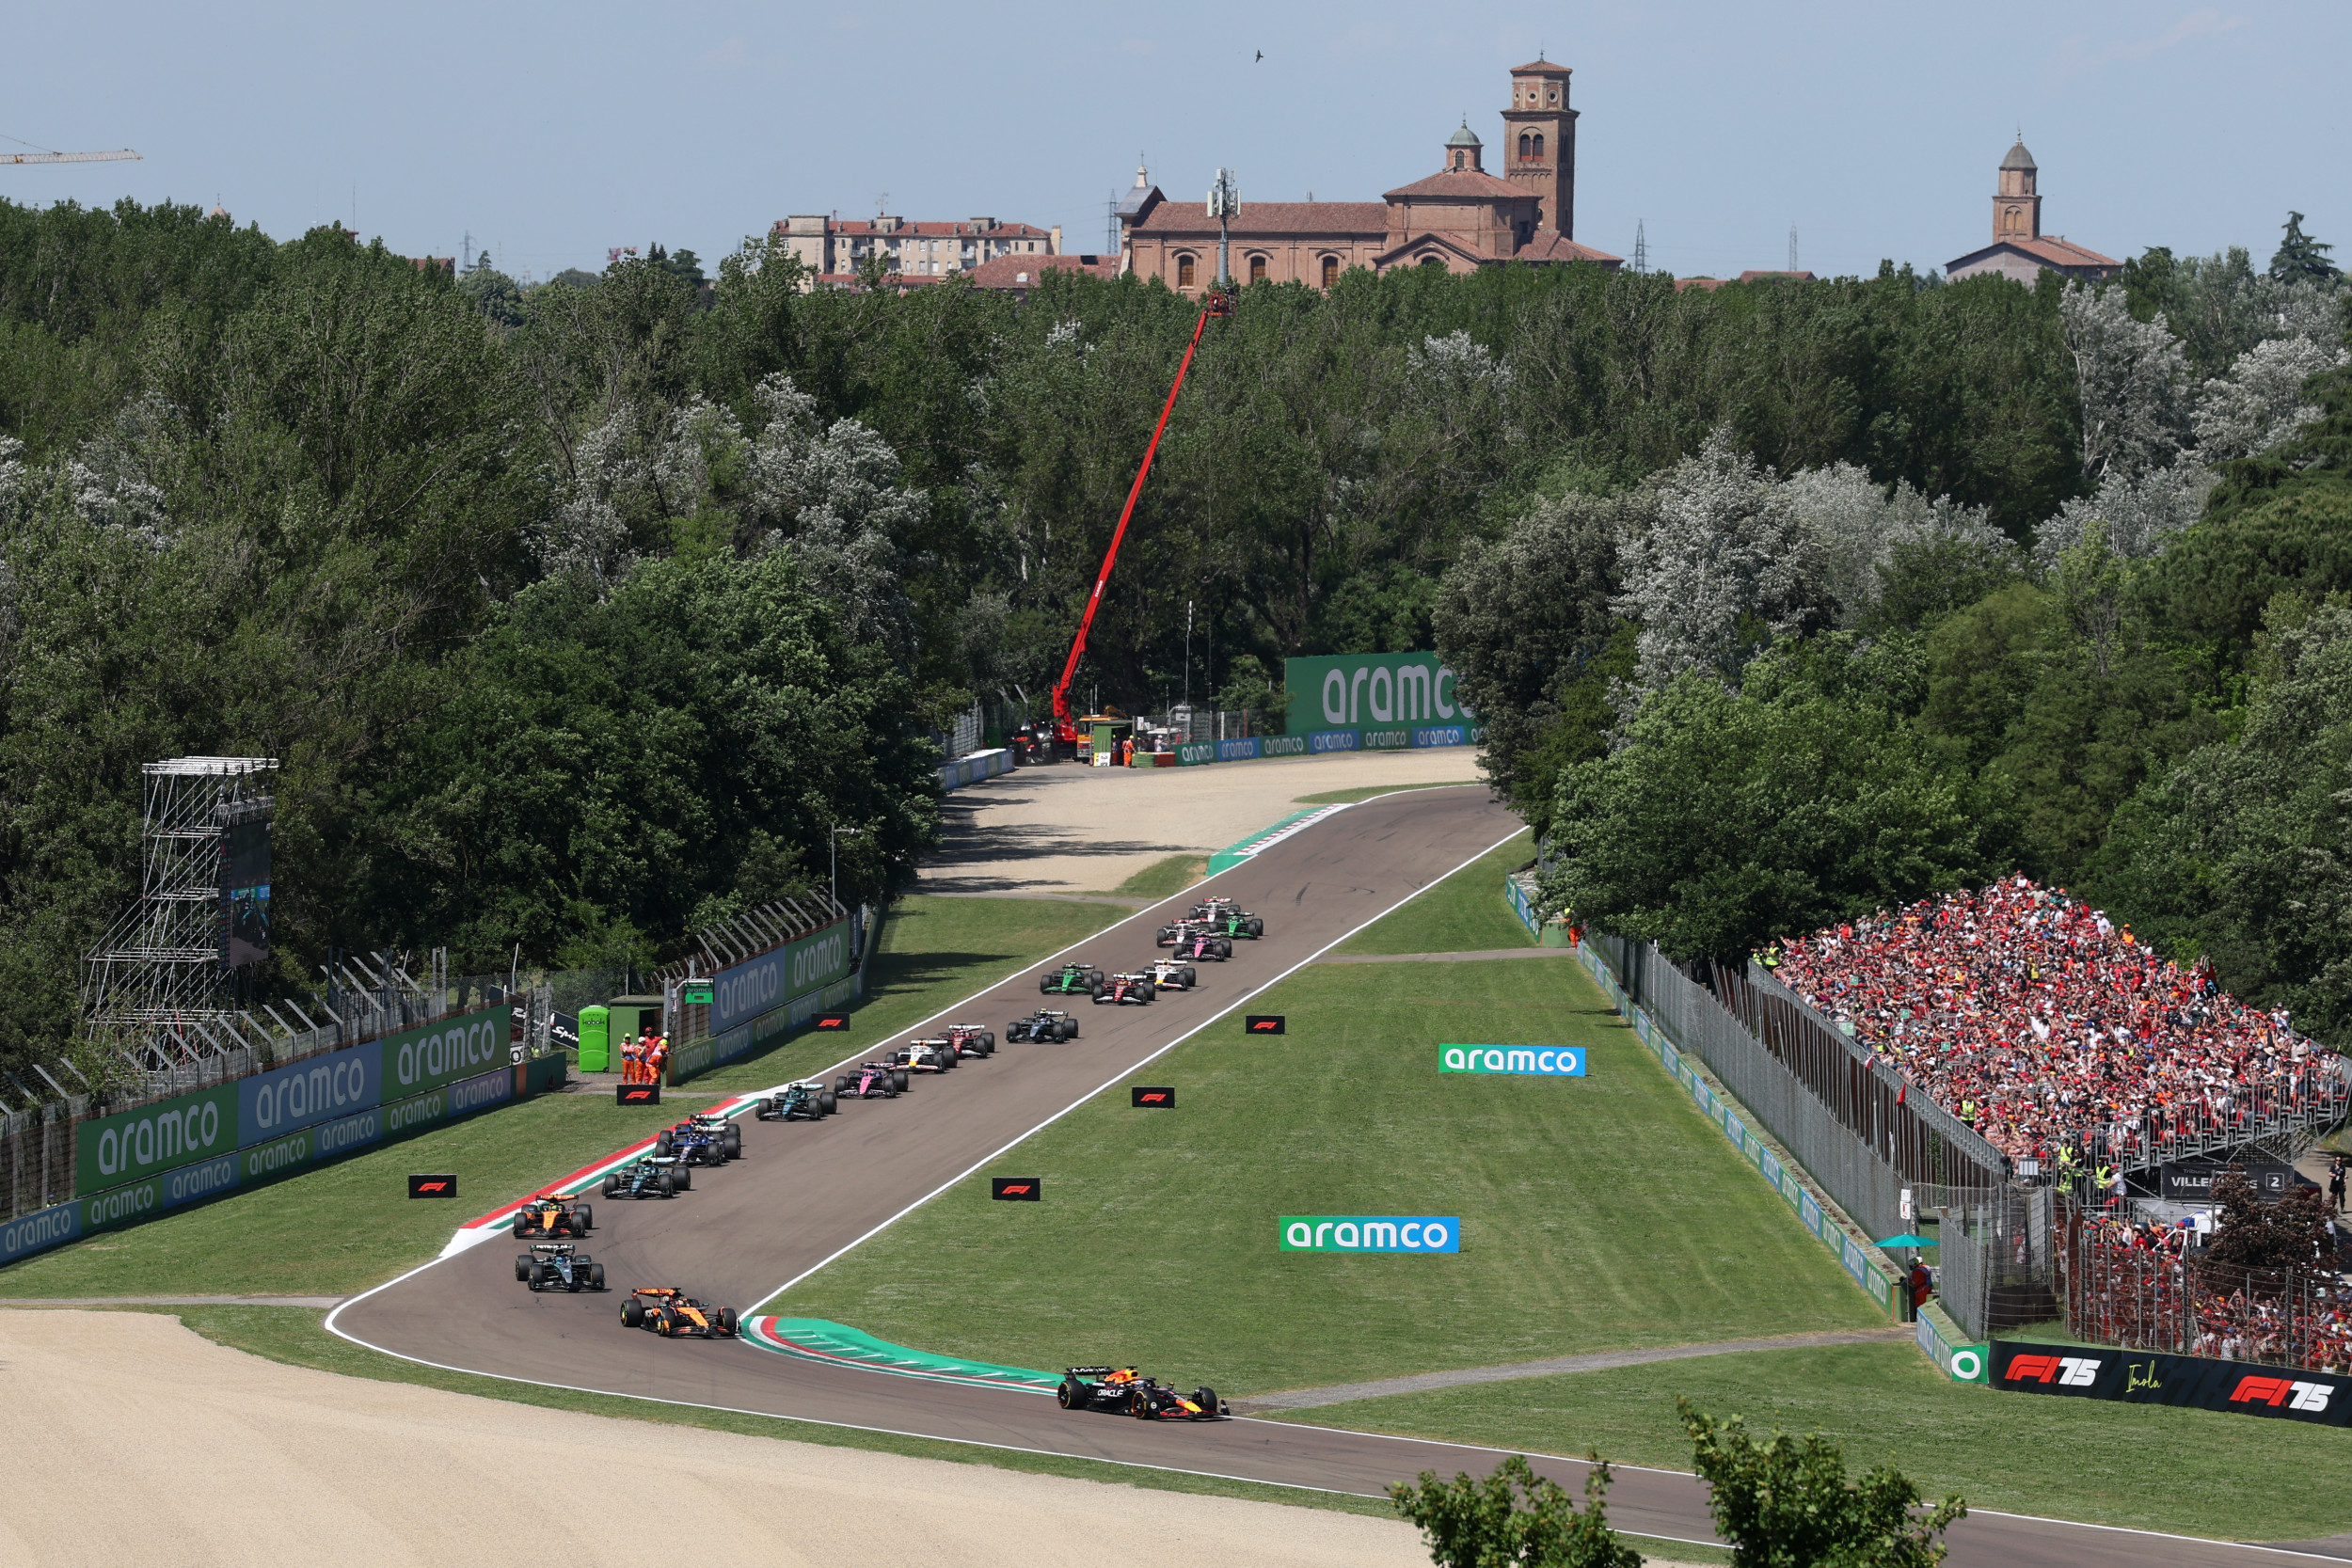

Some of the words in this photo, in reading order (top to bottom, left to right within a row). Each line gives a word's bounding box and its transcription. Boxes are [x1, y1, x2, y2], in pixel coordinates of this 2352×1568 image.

[1222, 741, 1254, 758] aramco
[1264, 736, 1304, 754] aramco
[1314, 732, 1353, 750] aramco
[1366, 731, 1406, 747] aramco
[1419, 729, 1459, 746] aramco
[1182, 745, 1214, 762] aramco
[794, 933, 841, 988] aramco
[720, 961, 777, 1020] aramco
[756, 1011, 785, 1041] aramco
[818, 1019, 843, 1027] F1
[1253, 1022, 1278, 1030] F1
[398, 1020, 496, 1085] aramco
[719, 1028, 749, 1059] aramco
[678, 1044, 711, 1075] aramco
[1445, 1048, 1578, 1072] aramco
[256, 1057, 365, 1129] aramco
[455, 1075, 504, 1110] aramco
[625, 1091, 651, 1100] F1
[1140, 1093, 1167, 1102] F1
[390, 1095, 441, 1130] aramco
[99, 1101, 218, 1176] aramco
[322, 1115, 374, 1151] aramco
[249, 1136, 306, 1175] aramco
[172, 1161, 231, 1199] aramco
[418, 1181, 447, 1192] F1
[1001, 1184, 1030, 1194] F1
[2270, 1177, 2280, 1188] 2
[91, 1184, 153, 1225] aramco
[6, 1209, 72, 1252] aramco
[1286, 1222, 1449, 1248] aramco
[1844, 1239, 1864, 1280] aramco
[1867, 1265, 1887, 1306] aramco
[2125, 1359, 2163, 1393] Imola
[1098, 1389, 1123, 1398] ORACLE
